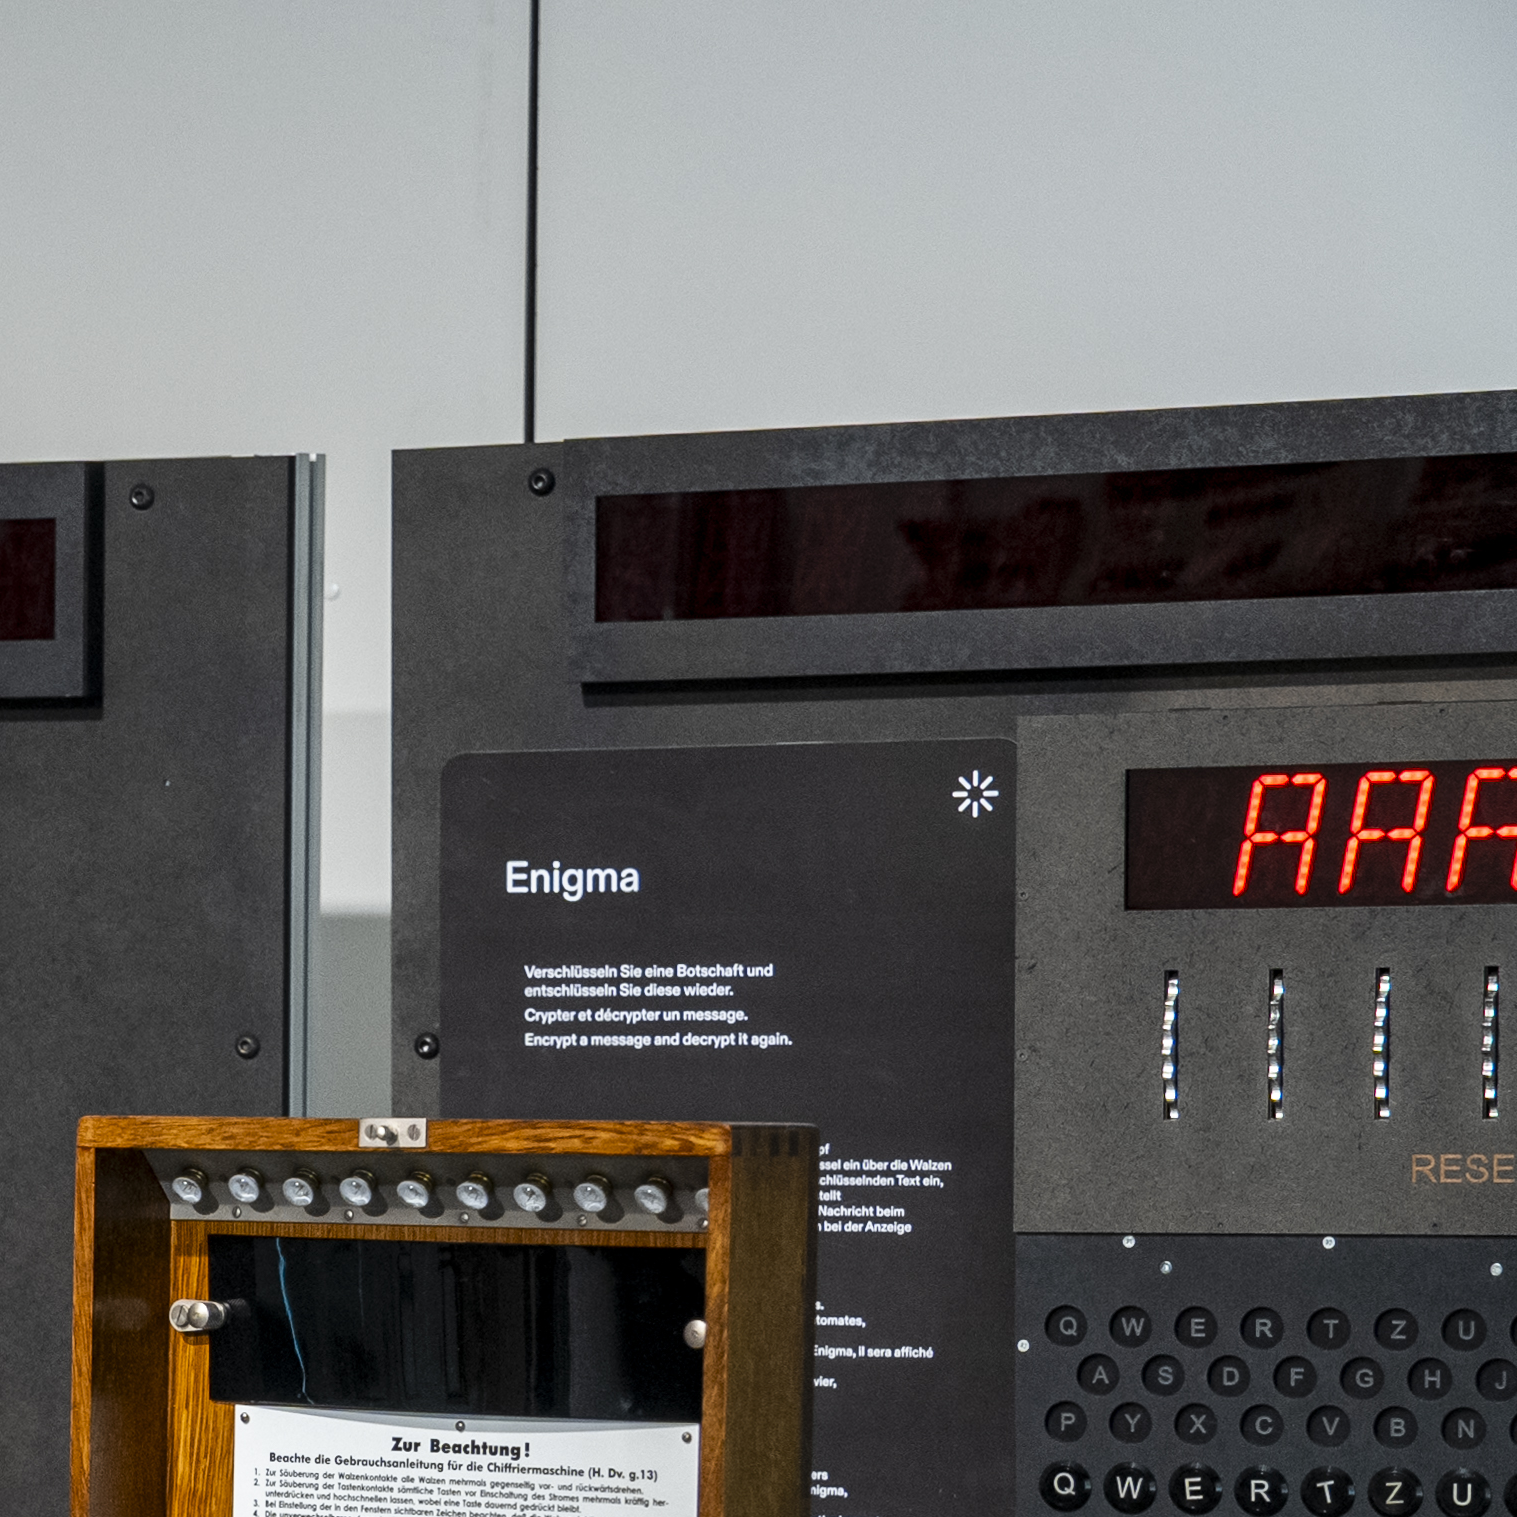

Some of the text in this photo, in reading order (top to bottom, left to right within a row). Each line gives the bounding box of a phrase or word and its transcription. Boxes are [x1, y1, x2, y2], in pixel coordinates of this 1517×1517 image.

[1232, 768, 1517, 896] AAA
[506, 860, 639, 902] Enigma
[524, 963, 773, 978] Verschlüsseln Sie eine Botschaft und
[524, 983, 734, 997] entschlüsseln Sie diese wieder.
[524, 1007, 748, 1024] Crypter et décrypter un message.
[524, 1032, 792, 1049] Encrypt a message and decrypt it again.
[843, 1159, 860, 1171] ein
[862, 1158, 889, 1171] über
[890, 1159, 908, 1171] die
[909, 1159, 952, 1171] Walzen
[1411, 1154, 1515, 1184] RESE
[896, 1174, 921, 1187] Text
[922, 1175, 944, 1189] ein,
[818, 1204, 905, 1217] Nachricht beim
[824, 1220, 912, 1236] bei der Anzeige
[858, 1345, 866, 1357] il
[867, 1347, 892, 1358] sera
[894, 1346, 934, 1359] affiché
[391, 1436, 530, 1461] Zur Beachtung!
[269, 1452, 658, 1483] Beachte die Gebrauchsanleitung für die Chiffriermaschine (H. Dv. g.13)
[1054, 1472, 1472, 1506] Q W E R T Z U
